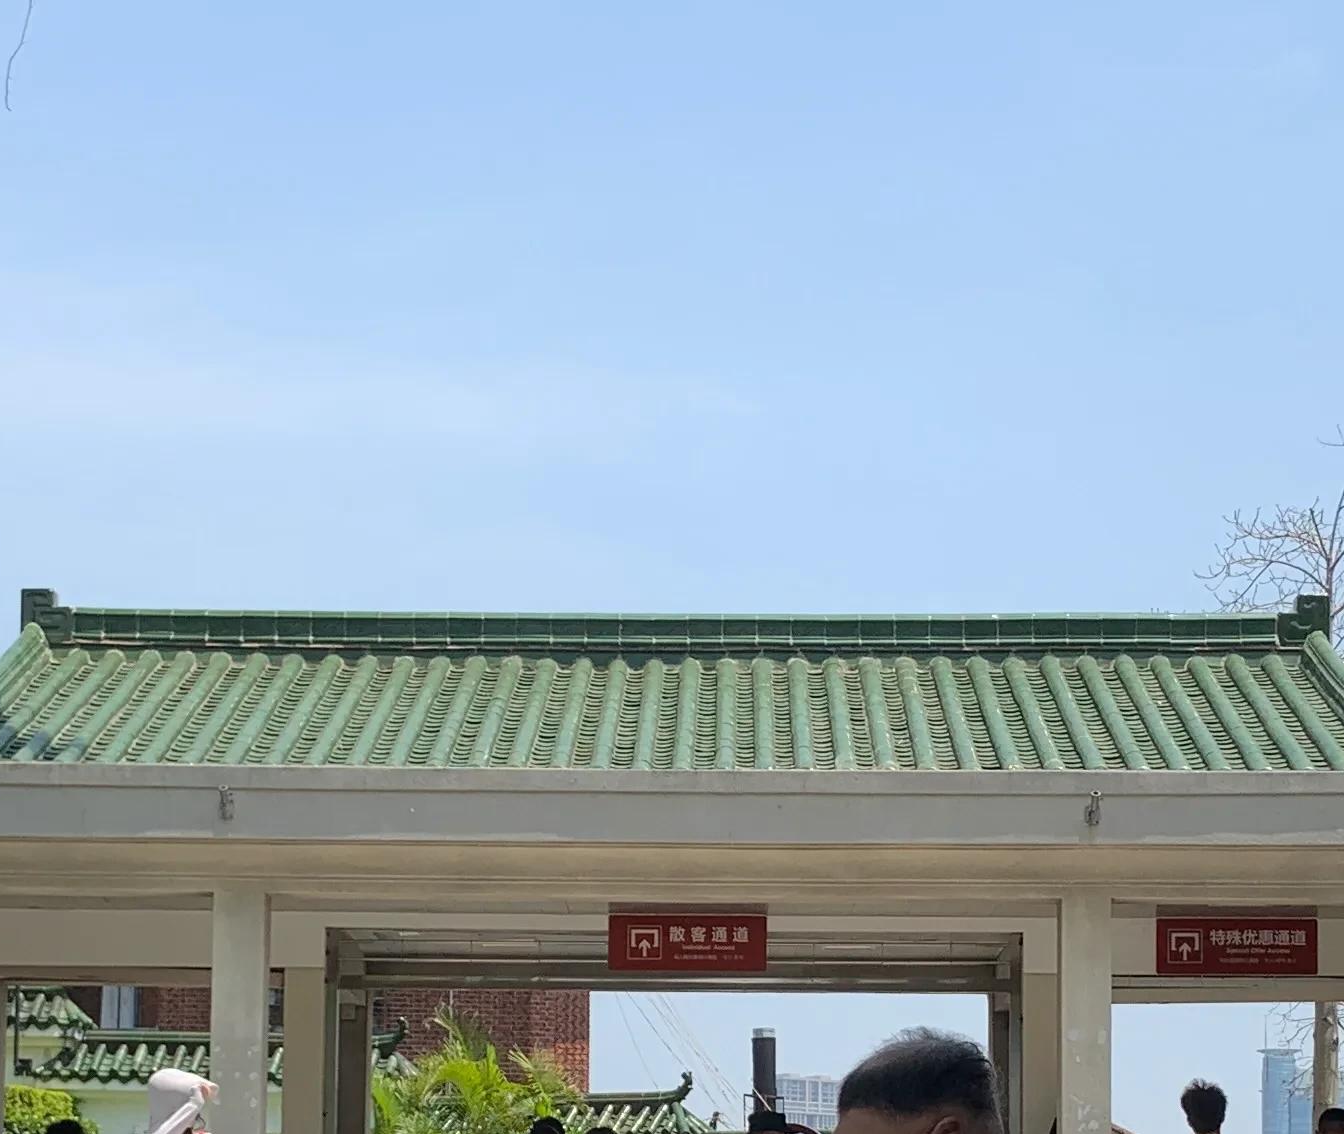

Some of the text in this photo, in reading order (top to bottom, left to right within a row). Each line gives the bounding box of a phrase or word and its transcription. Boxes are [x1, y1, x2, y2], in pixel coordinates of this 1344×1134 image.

[669, 926, 749, 943] 散客通道
[1209, 929, 1307, 946] 特殊优惠通道
